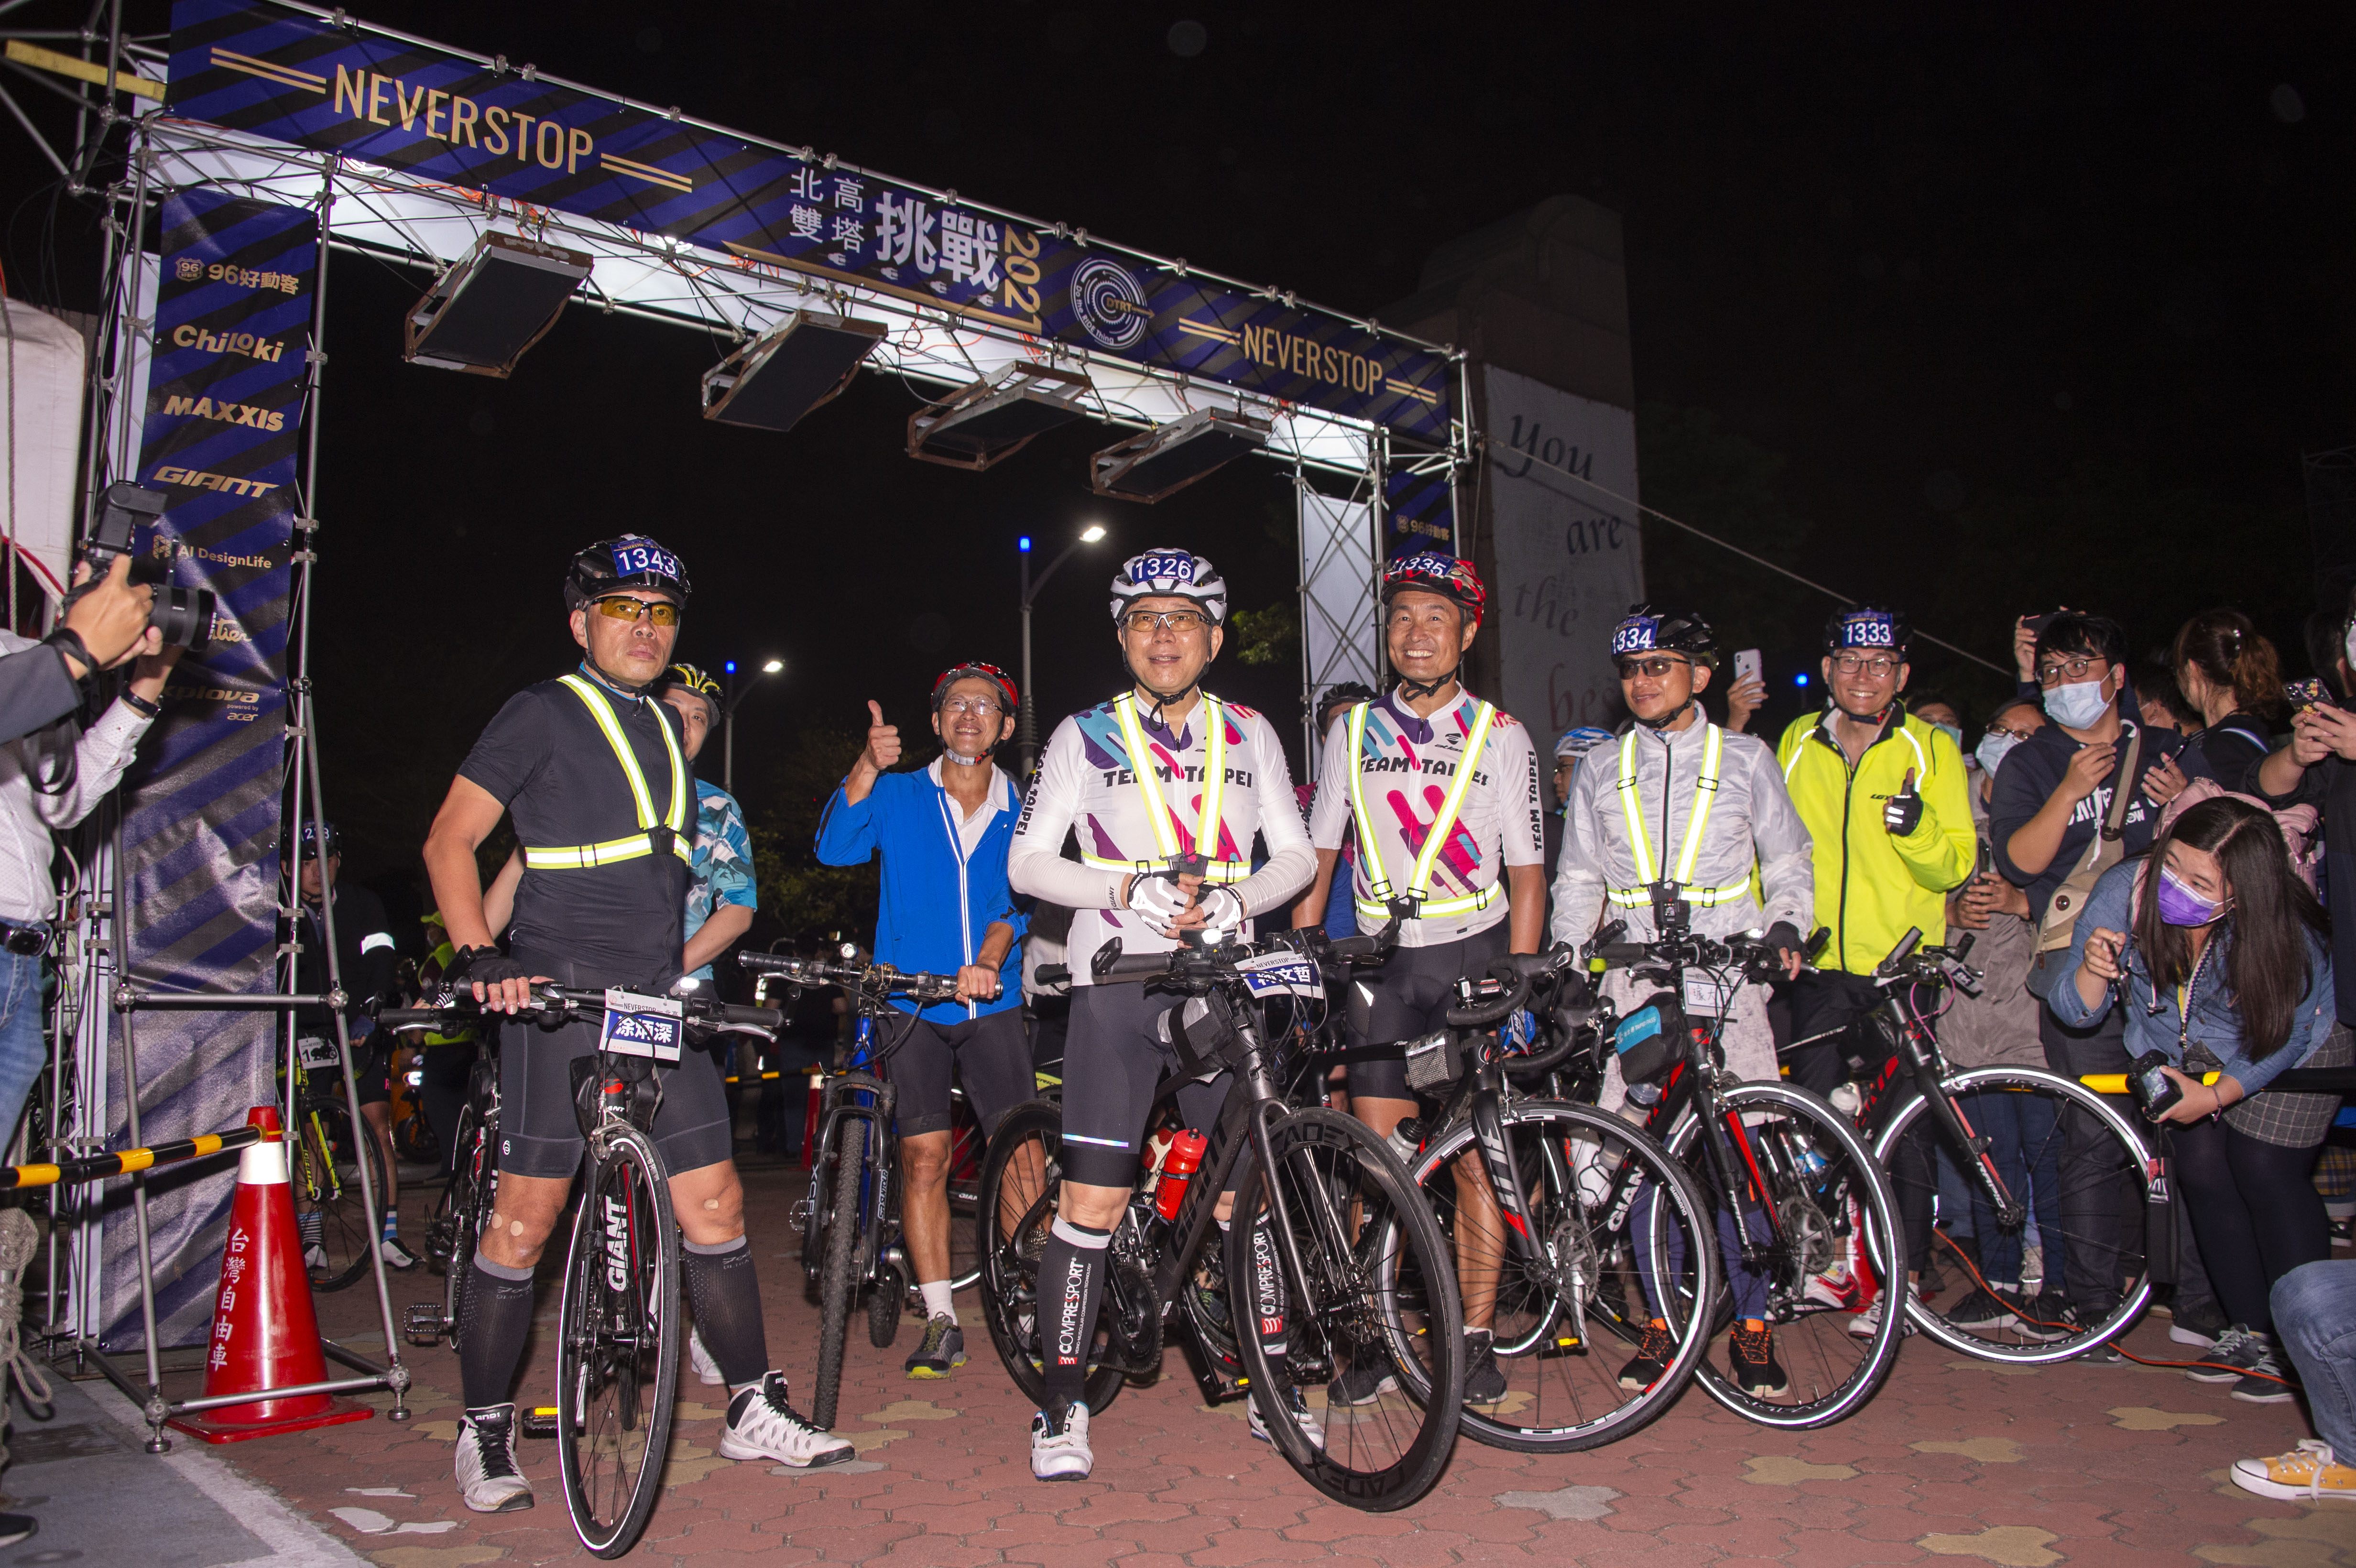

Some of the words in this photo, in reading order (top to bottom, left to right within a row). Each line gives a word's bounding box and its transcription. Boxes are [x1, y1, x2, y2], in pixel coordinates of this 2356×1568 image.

[335, 63, 593, 174] NEVERSTOP
[790, 167, 864, 213] 北高
[790, 205, 864, 253] 雙塔
[875, 191, 1000, 292] 挑戰
[182, 262, 199, 272] 96
[208, 264, 299, 295] 96好動客
[1004, 224, 1042, 335] 2021
[1106, 298, 1132, 313] DTRT
[1244, 323, 1383, 395] NEVERSTOP
[164, 395, 284, 432] MAXXIS
[153, 466, 280, 498] GIANT
[178, 546, 194, 557] AI
[198, 548, 272, 569] DesignLife
[619, 548, 676, 575] 1343
[1135, 558, 1191, 579] 1326
[1398, 557, 1447, 576] 1335
[1847, 622, 1891, 643] 1333
[227, 712, 259, 722] acer
[1421, 758, 1489, 786] TAIEI
[1527, 751, 1538, 804] TAIPEI
[1014, 789, 1038, 836] TAIPEI
[1532, 809, 1542, 851] TEAM
[1256, 957, 1289, 969] NEVERSTOP
[624, 1002, 656, 1012] NEVERSTOP
[959, 1192, 978, 1201] GIAN
[1607, 1165, 1646, 1232] GIAN
[605, 1196, 628, 1292] GIANT
[210, 1228, 250, 1372] 台灣自由車
